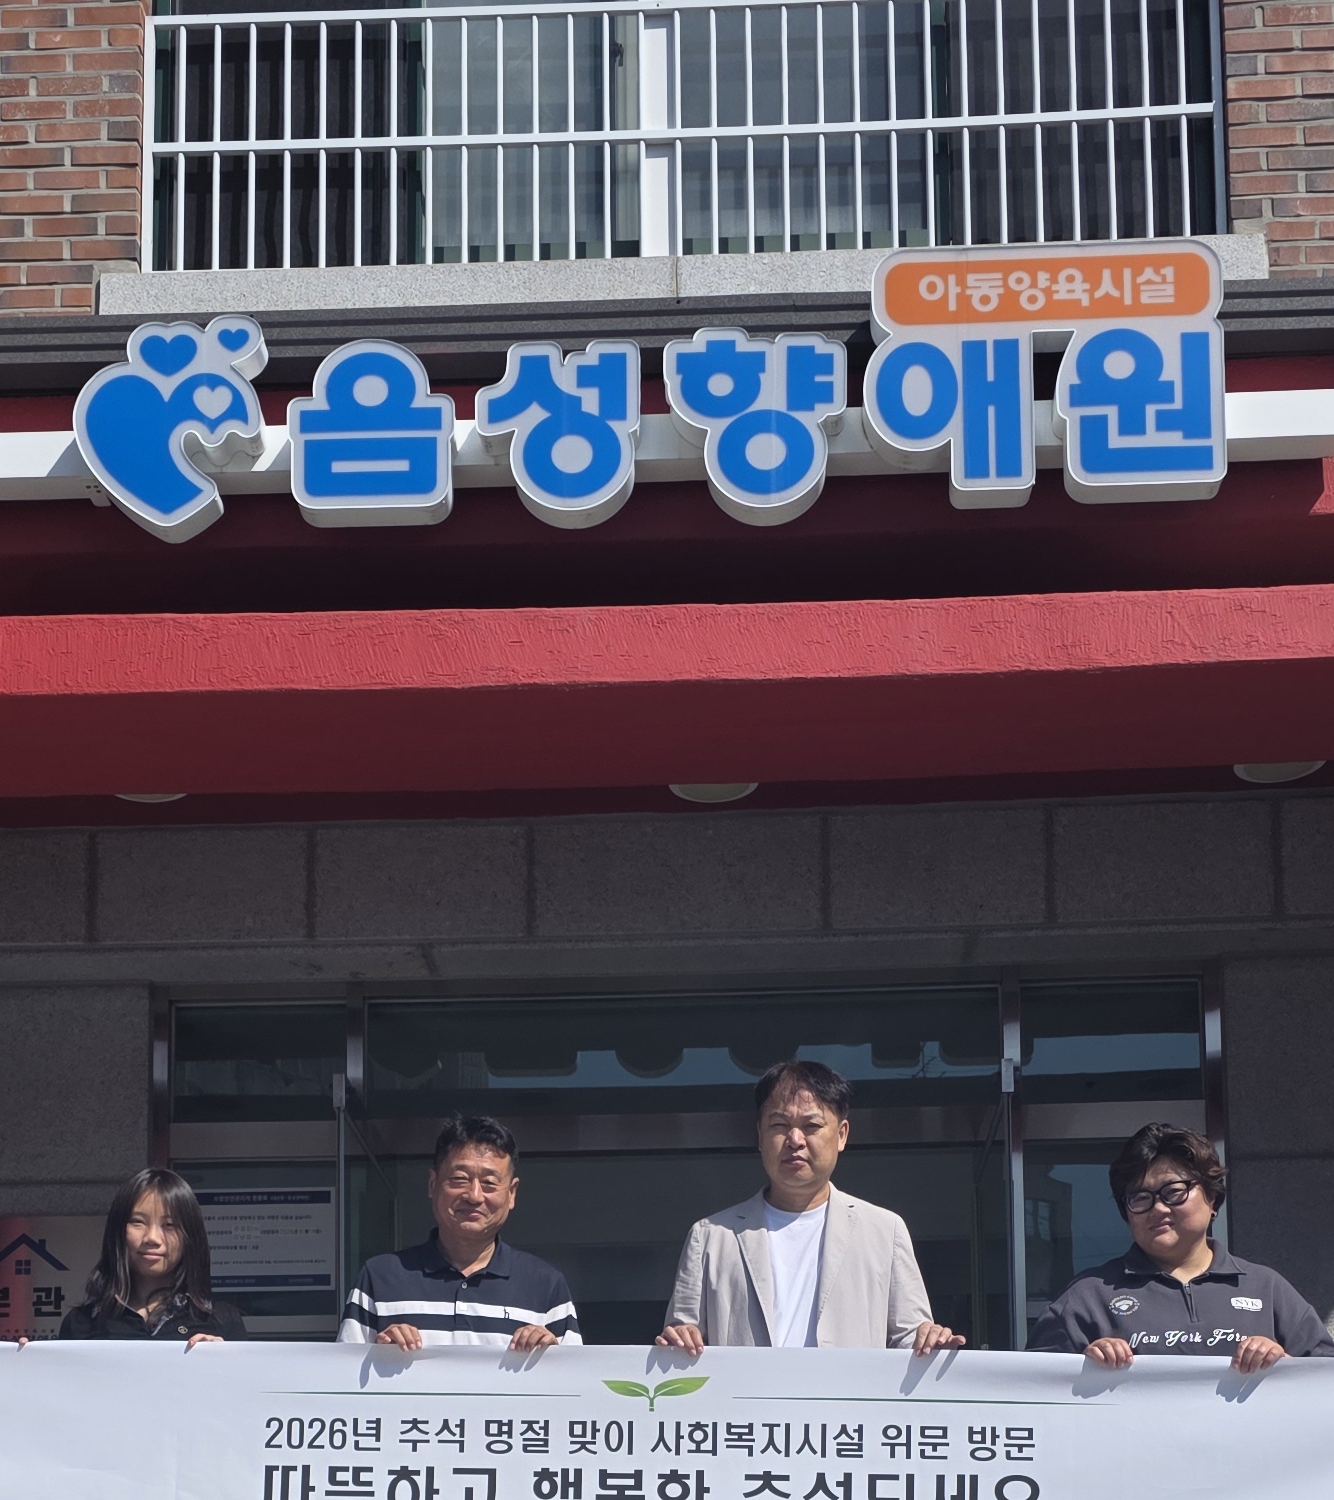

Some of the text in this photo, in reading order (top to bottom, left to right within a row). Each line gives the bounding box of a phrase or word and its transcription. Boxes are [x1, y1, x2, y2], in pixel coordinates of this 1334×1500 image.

[917, 262, 1178, 312] 아동양육시설
[299, 329, 1215, 498] 음성향애원
[1235, 1299, 1259, 1308] NYK
[1129, 1332, 1159, 1348] New
[1165, 1330, 1202, 1347] York
[265, 1417, 1036, 1462] 2026년 추석 명절 맞이 사회복지시설 위문 방문
